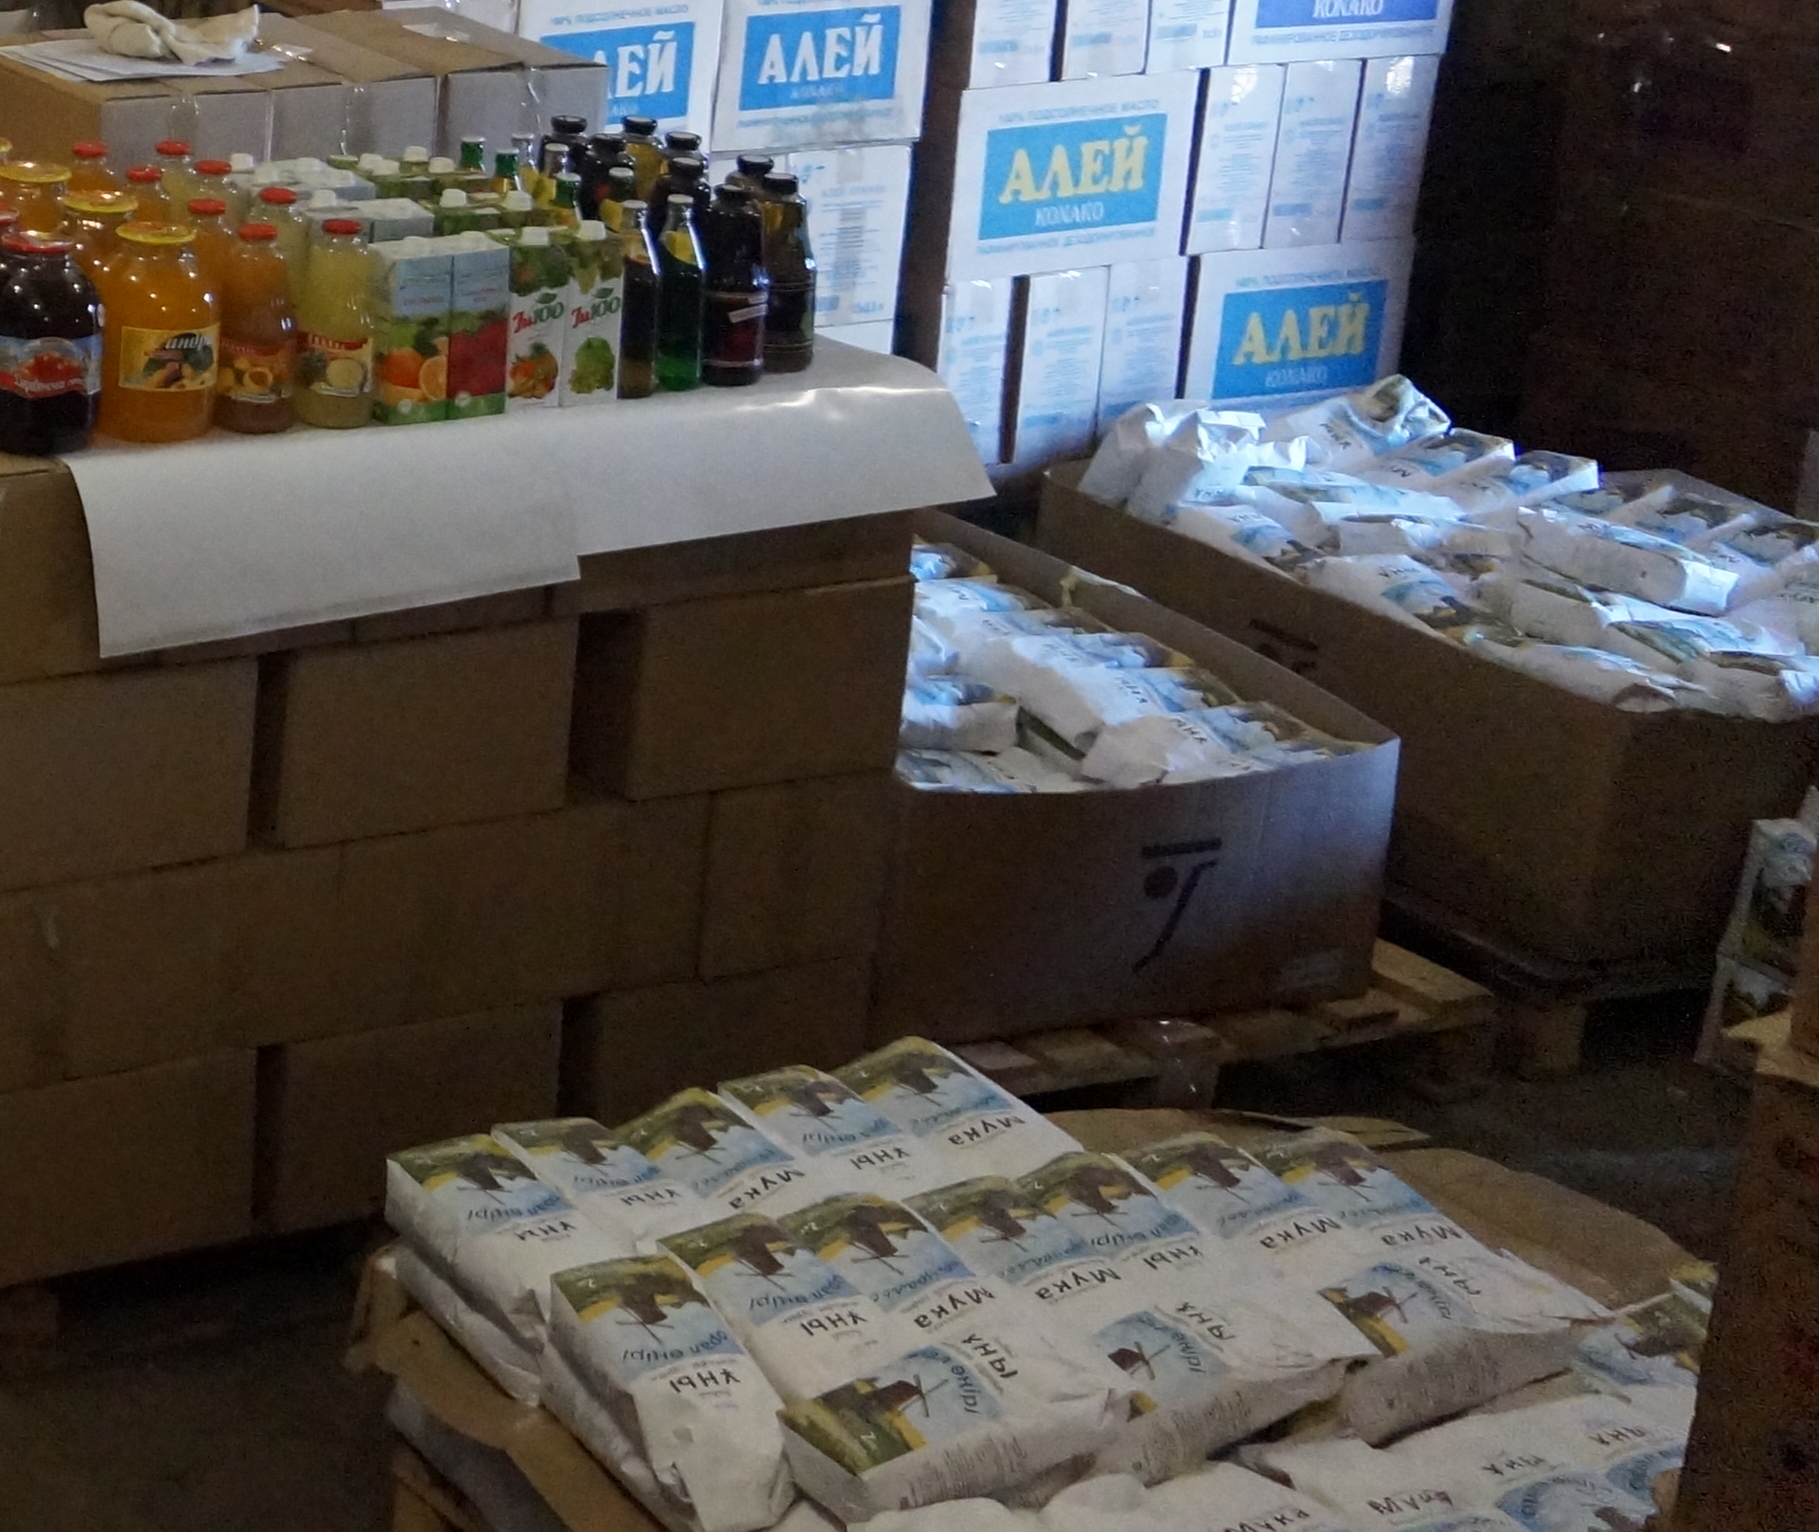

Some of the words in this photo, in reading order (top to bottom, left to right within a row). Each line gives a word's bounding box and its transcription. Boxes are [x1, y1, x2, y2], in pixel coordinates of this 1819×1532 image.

[756, 13, 885, 86] АЛЕЙ
[998, 124, 1149, 205] АЛЕЙ
[1232, 290, 1371, 366] АЛЕЙ
[948, 1112, 1027, 1148] Мука
[850, 1146, 912, 1172] ҰНЫ
[618, 1185, 680, 1208] ҰНЫ
[728, 1166, 807, 1211] Мука
[1258, 1215, 1343, 1252] Мука
[1379, 1220, 1465, 1250] Мука
[1033, 1264, 1123, 1306] Мука
[799, 1306, 868, 1338] ҰНЫ
[911, 1283, 997, 1332] Мука
[1173, 1300, 1236, 1343] ҰНЫ
[960, 1333, 1021, 1384] ҰНЫ
[667, 1367, 743, 1396] ҰНЫ
